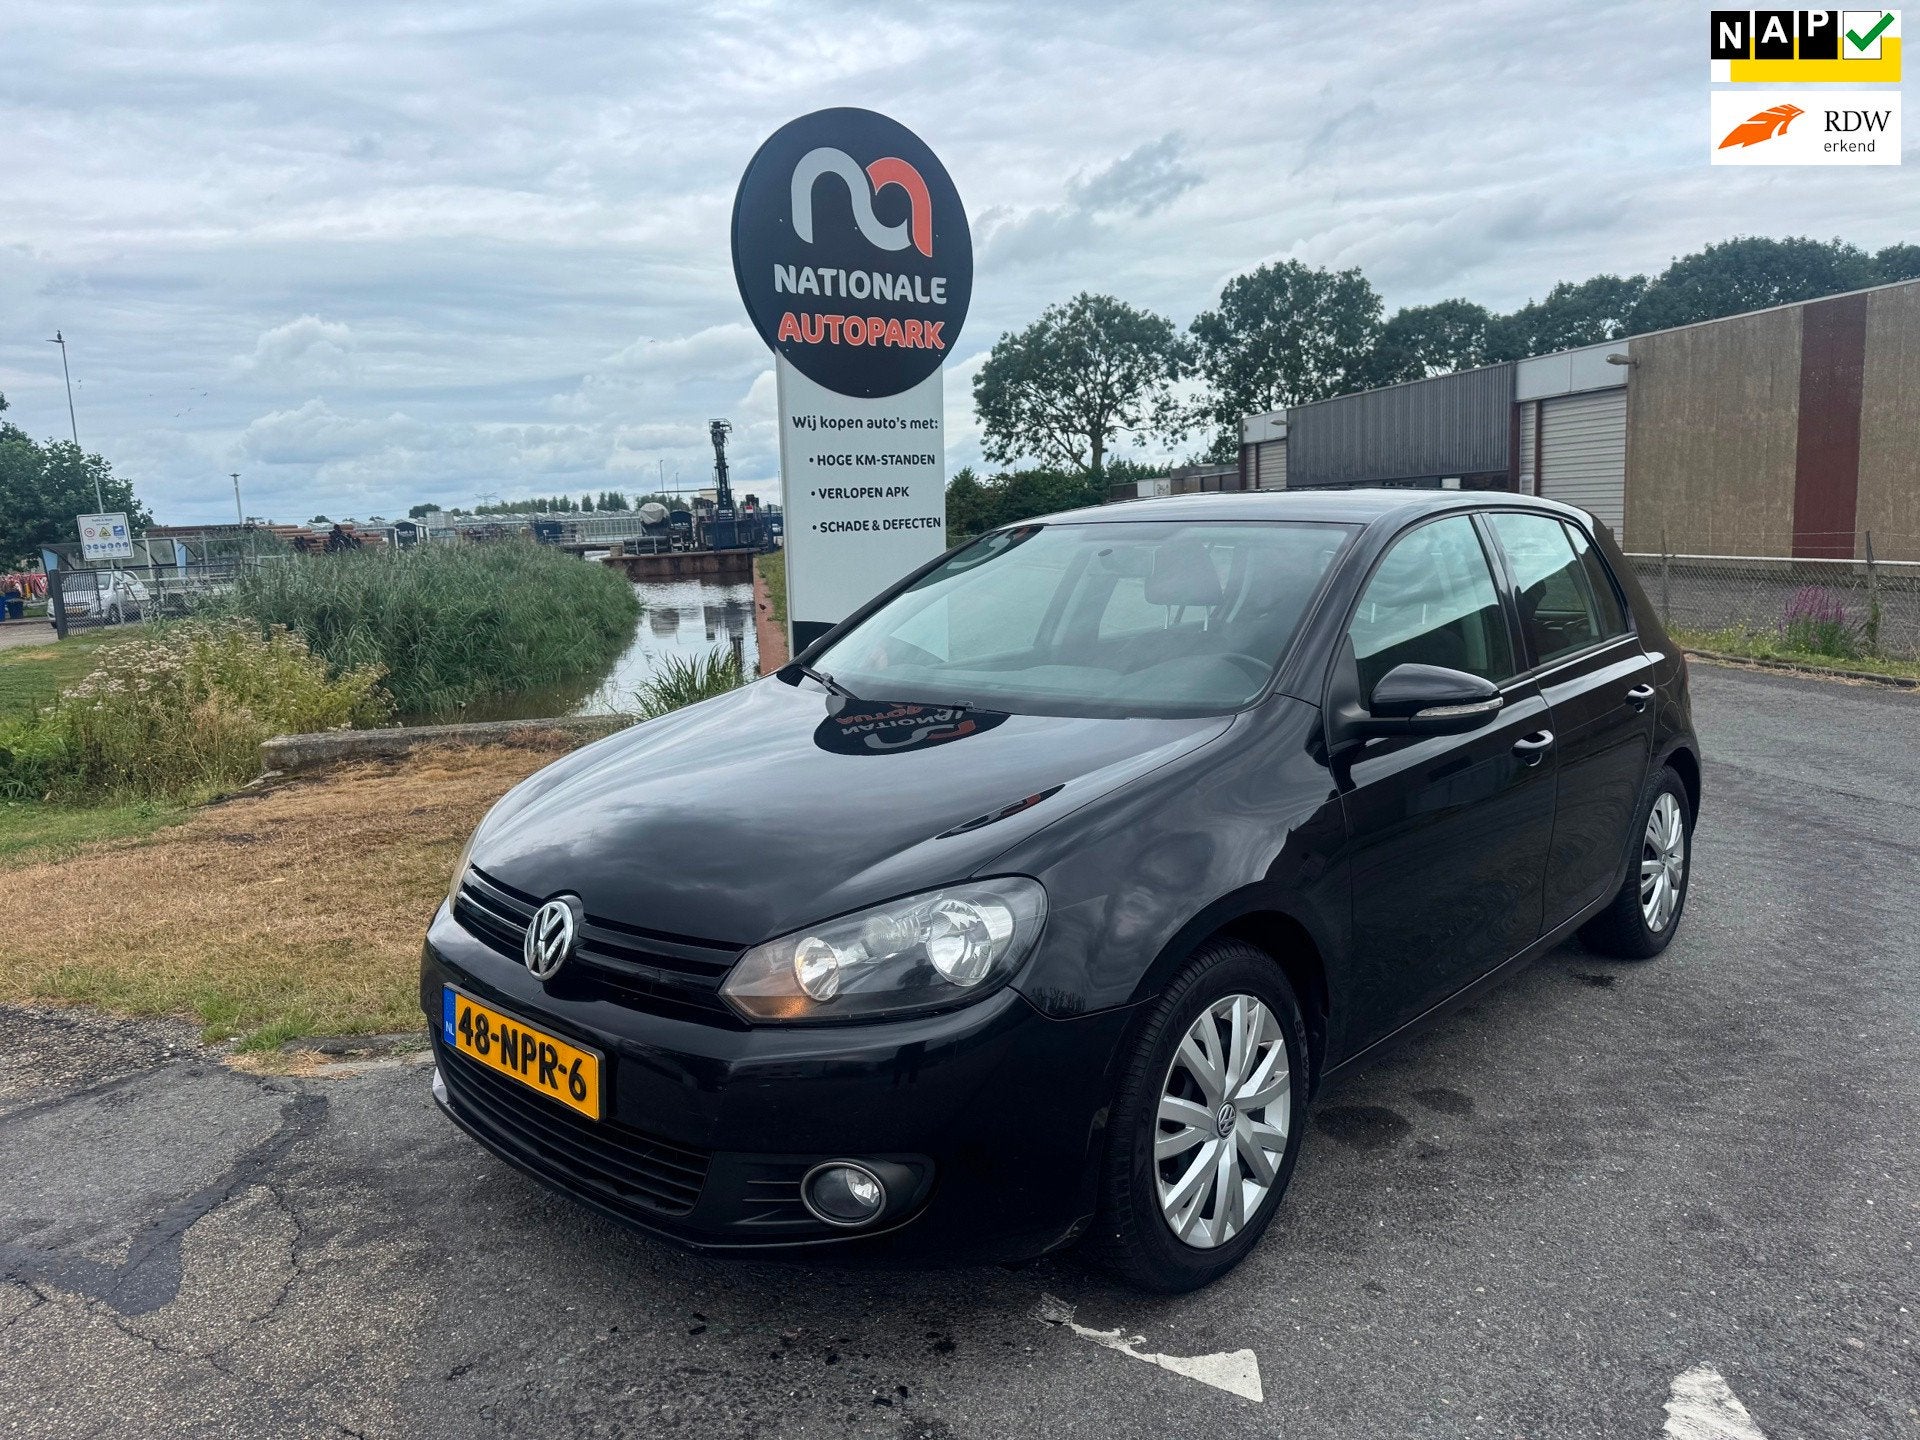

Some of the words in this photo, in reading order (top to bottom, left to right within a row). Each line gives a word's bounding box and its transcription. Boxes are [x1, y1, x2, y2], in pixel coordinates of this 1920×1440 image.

[773, 263, 948, 305] NATIONALE
[777, 311, 946, 350] AUTOPARK
[792, 415, 817, 431] Wij
[820, 415, 863, 431] kopen
[866, 416, 907, 430] auto's
[910, 417, 939, 430] met:
[817, 454, 853, 466] HOGE
[855, 454, 935, 466] KM-STANDEN
[818, 487, 883, 499] VERLOPEN
[885, 486, 910, 498] APK
[820, 520, 870, 533] SCHADE
[872, 519, 881, 531] &
[883, 517, 941, 530] DEFECTEN
[445, 1020, 455, 1036] NL
[457, 1006, 587, 1102] 48-NPR-6
